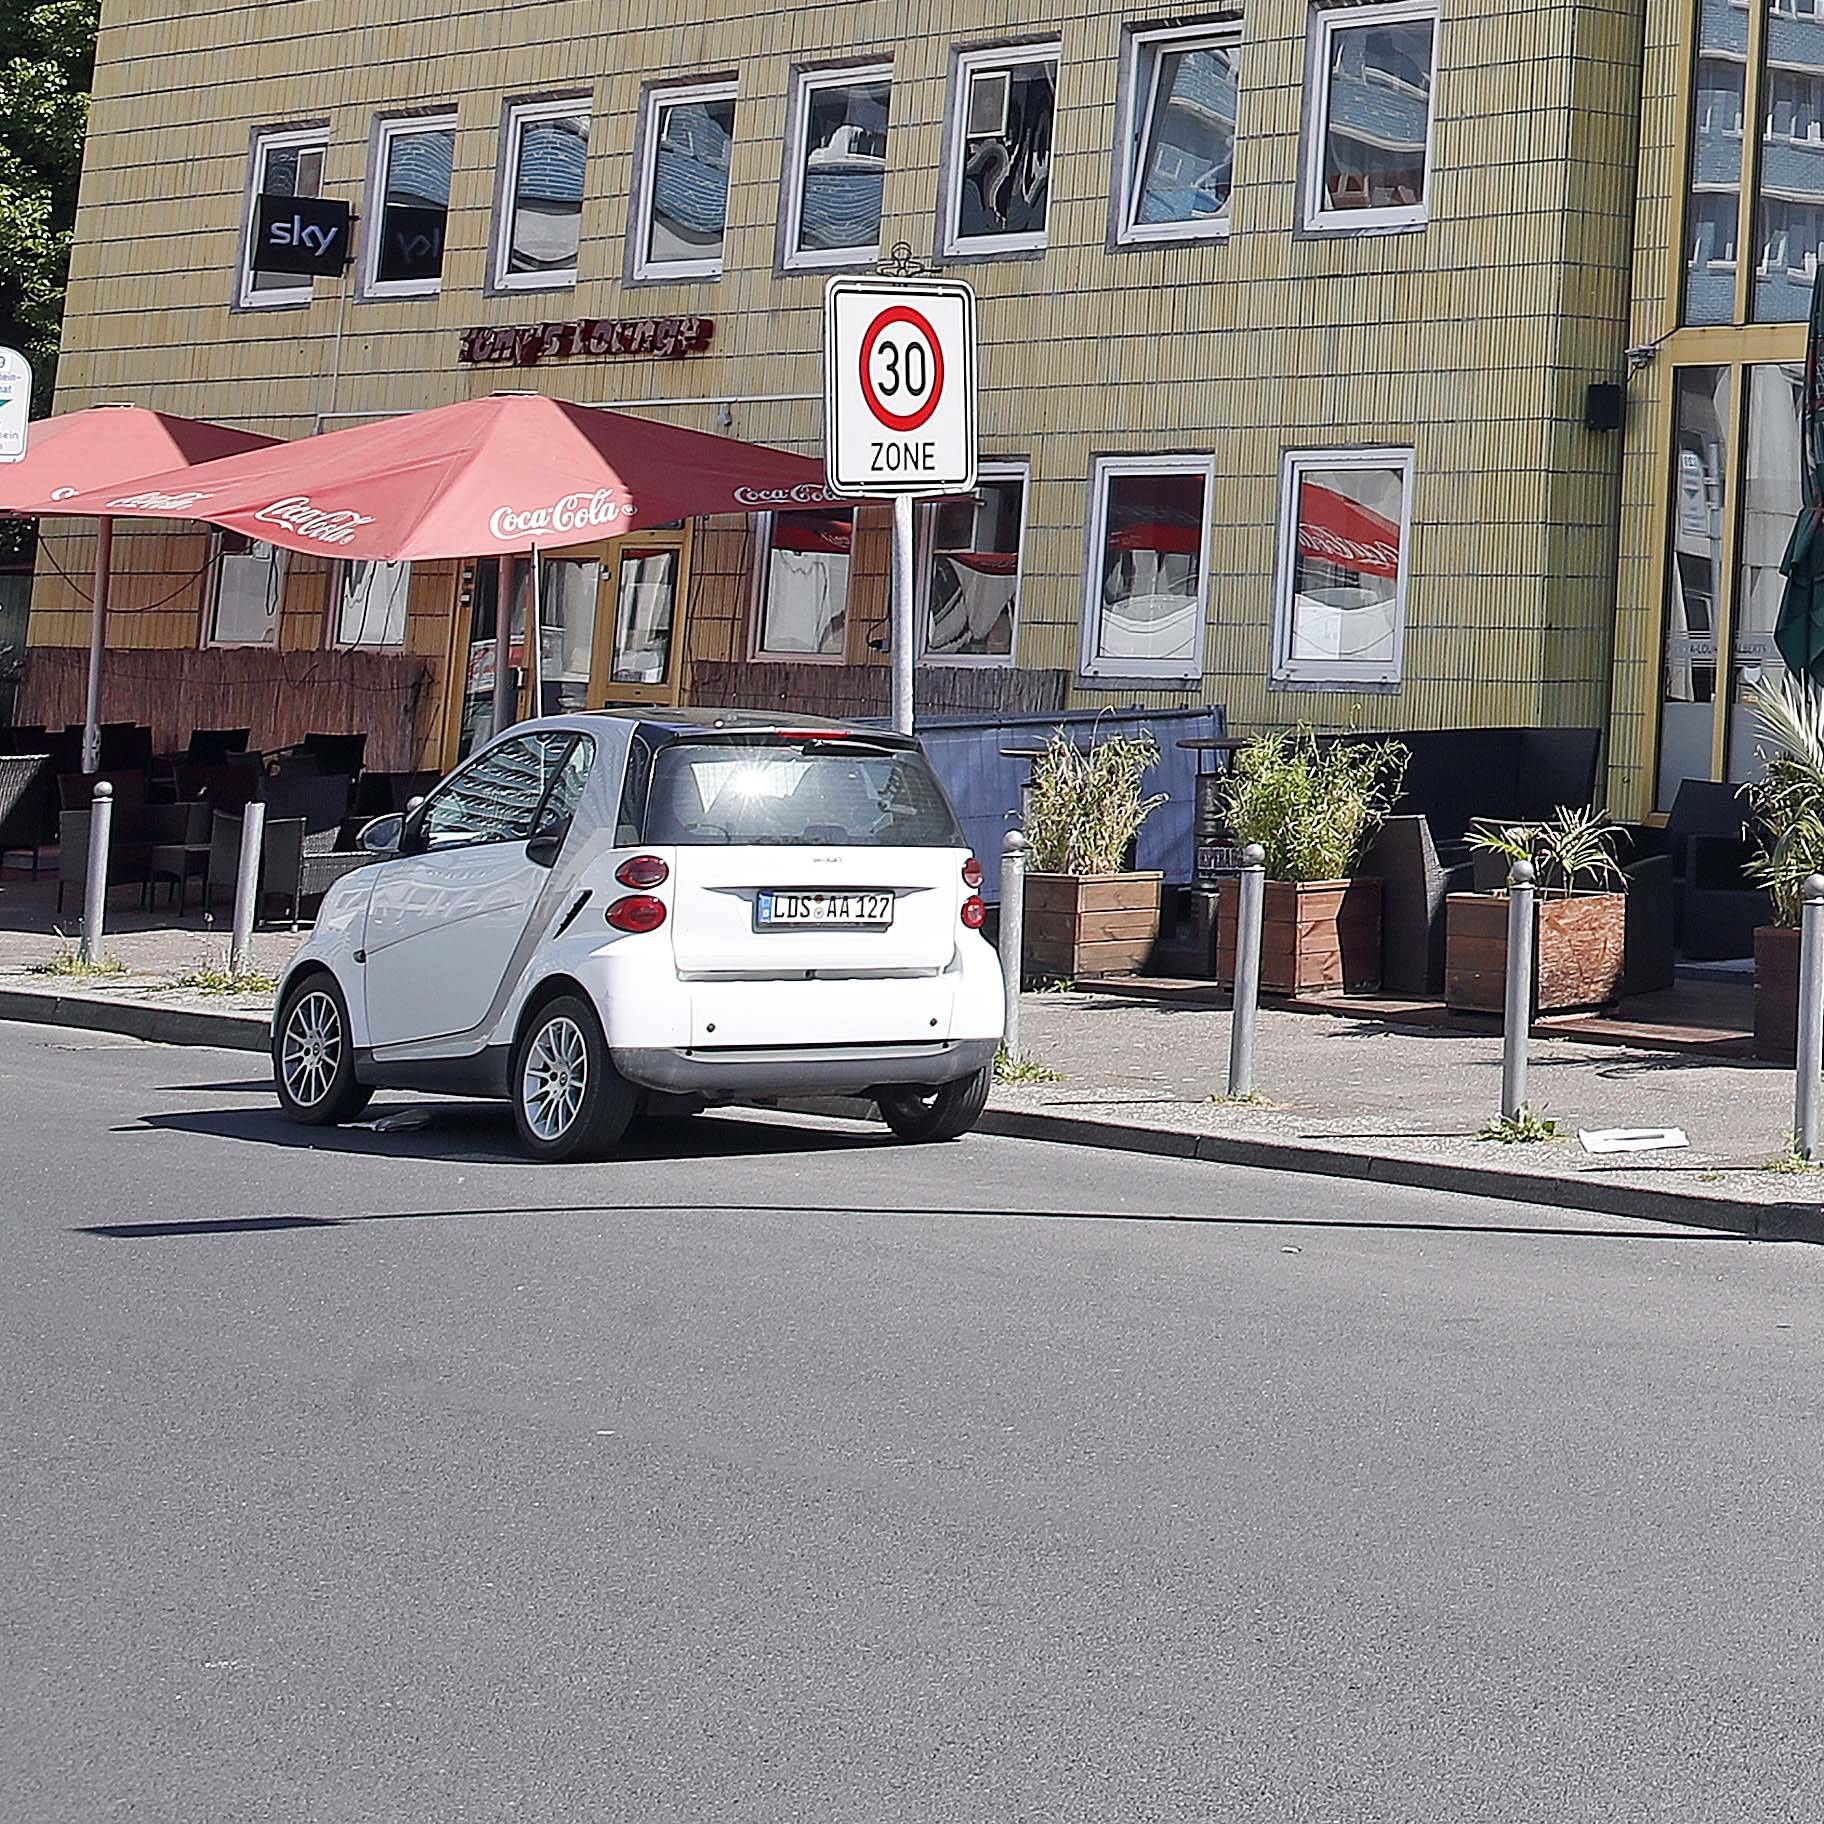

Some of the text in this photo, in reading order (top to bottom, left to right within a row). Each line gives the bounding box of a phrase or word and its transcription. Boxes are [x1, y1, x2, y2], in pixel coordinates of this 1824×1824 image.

[270, 215, 338, 256] sky
[877, 341, 926, 397] 30
[871, 442, 936, 472] ZONE
[489, 488, 619, 540] Coca-Cola
[774, 895, 890, 918] LDS AA 127
